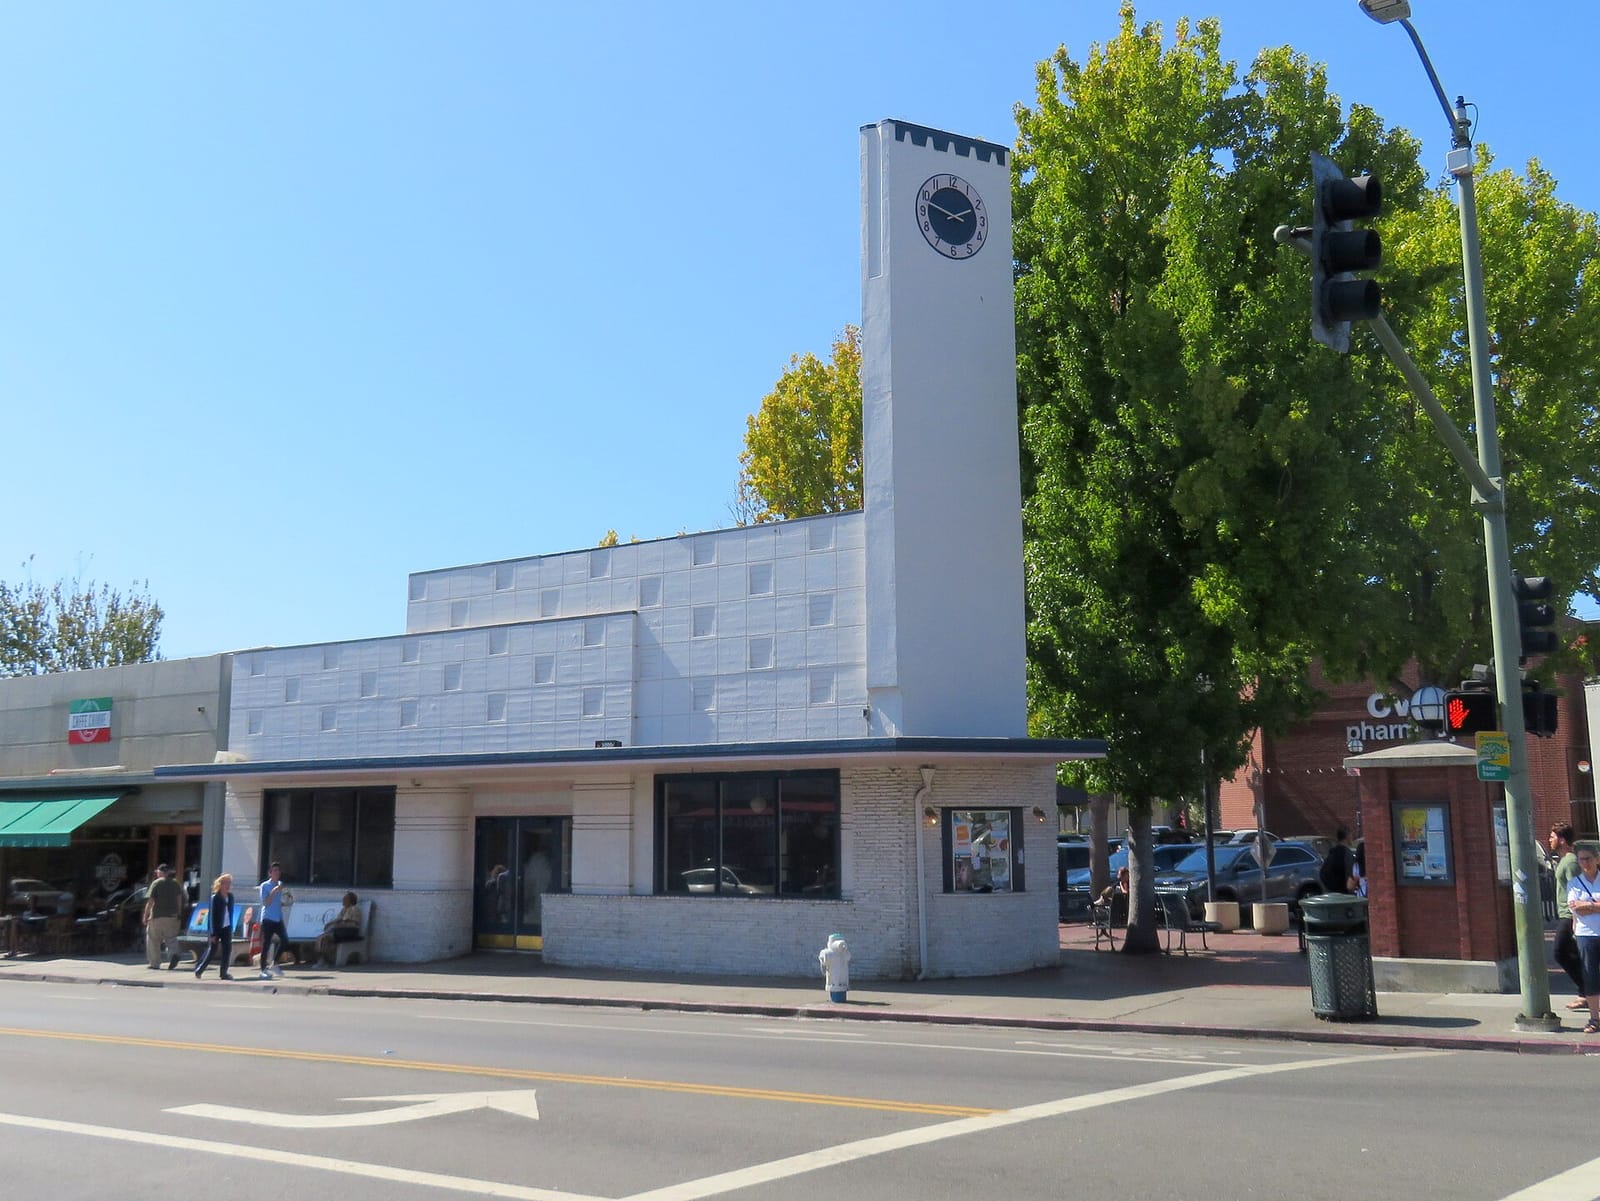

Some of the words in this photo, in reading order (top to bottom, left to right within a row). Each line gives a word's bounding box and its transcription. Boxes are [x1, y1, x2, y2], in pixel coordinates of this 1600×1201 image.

[932, 179, 939, 190] 11
[949, 175, 958, 188] 12
[922, 189, 930, 201] 10
[975, 199, 981, 210] 2
[920, 205, 926, 216] 9
[923, 221, 930, 232] 8
[980, 216, 986, 227] 3
[935, 234, 941, 247] 7
[976, 231, 982, 241] 4
[950, 246, 957, 256] 6
[966, 243, 973, 254] 5
[1367, 692, 1410, 719] CV
